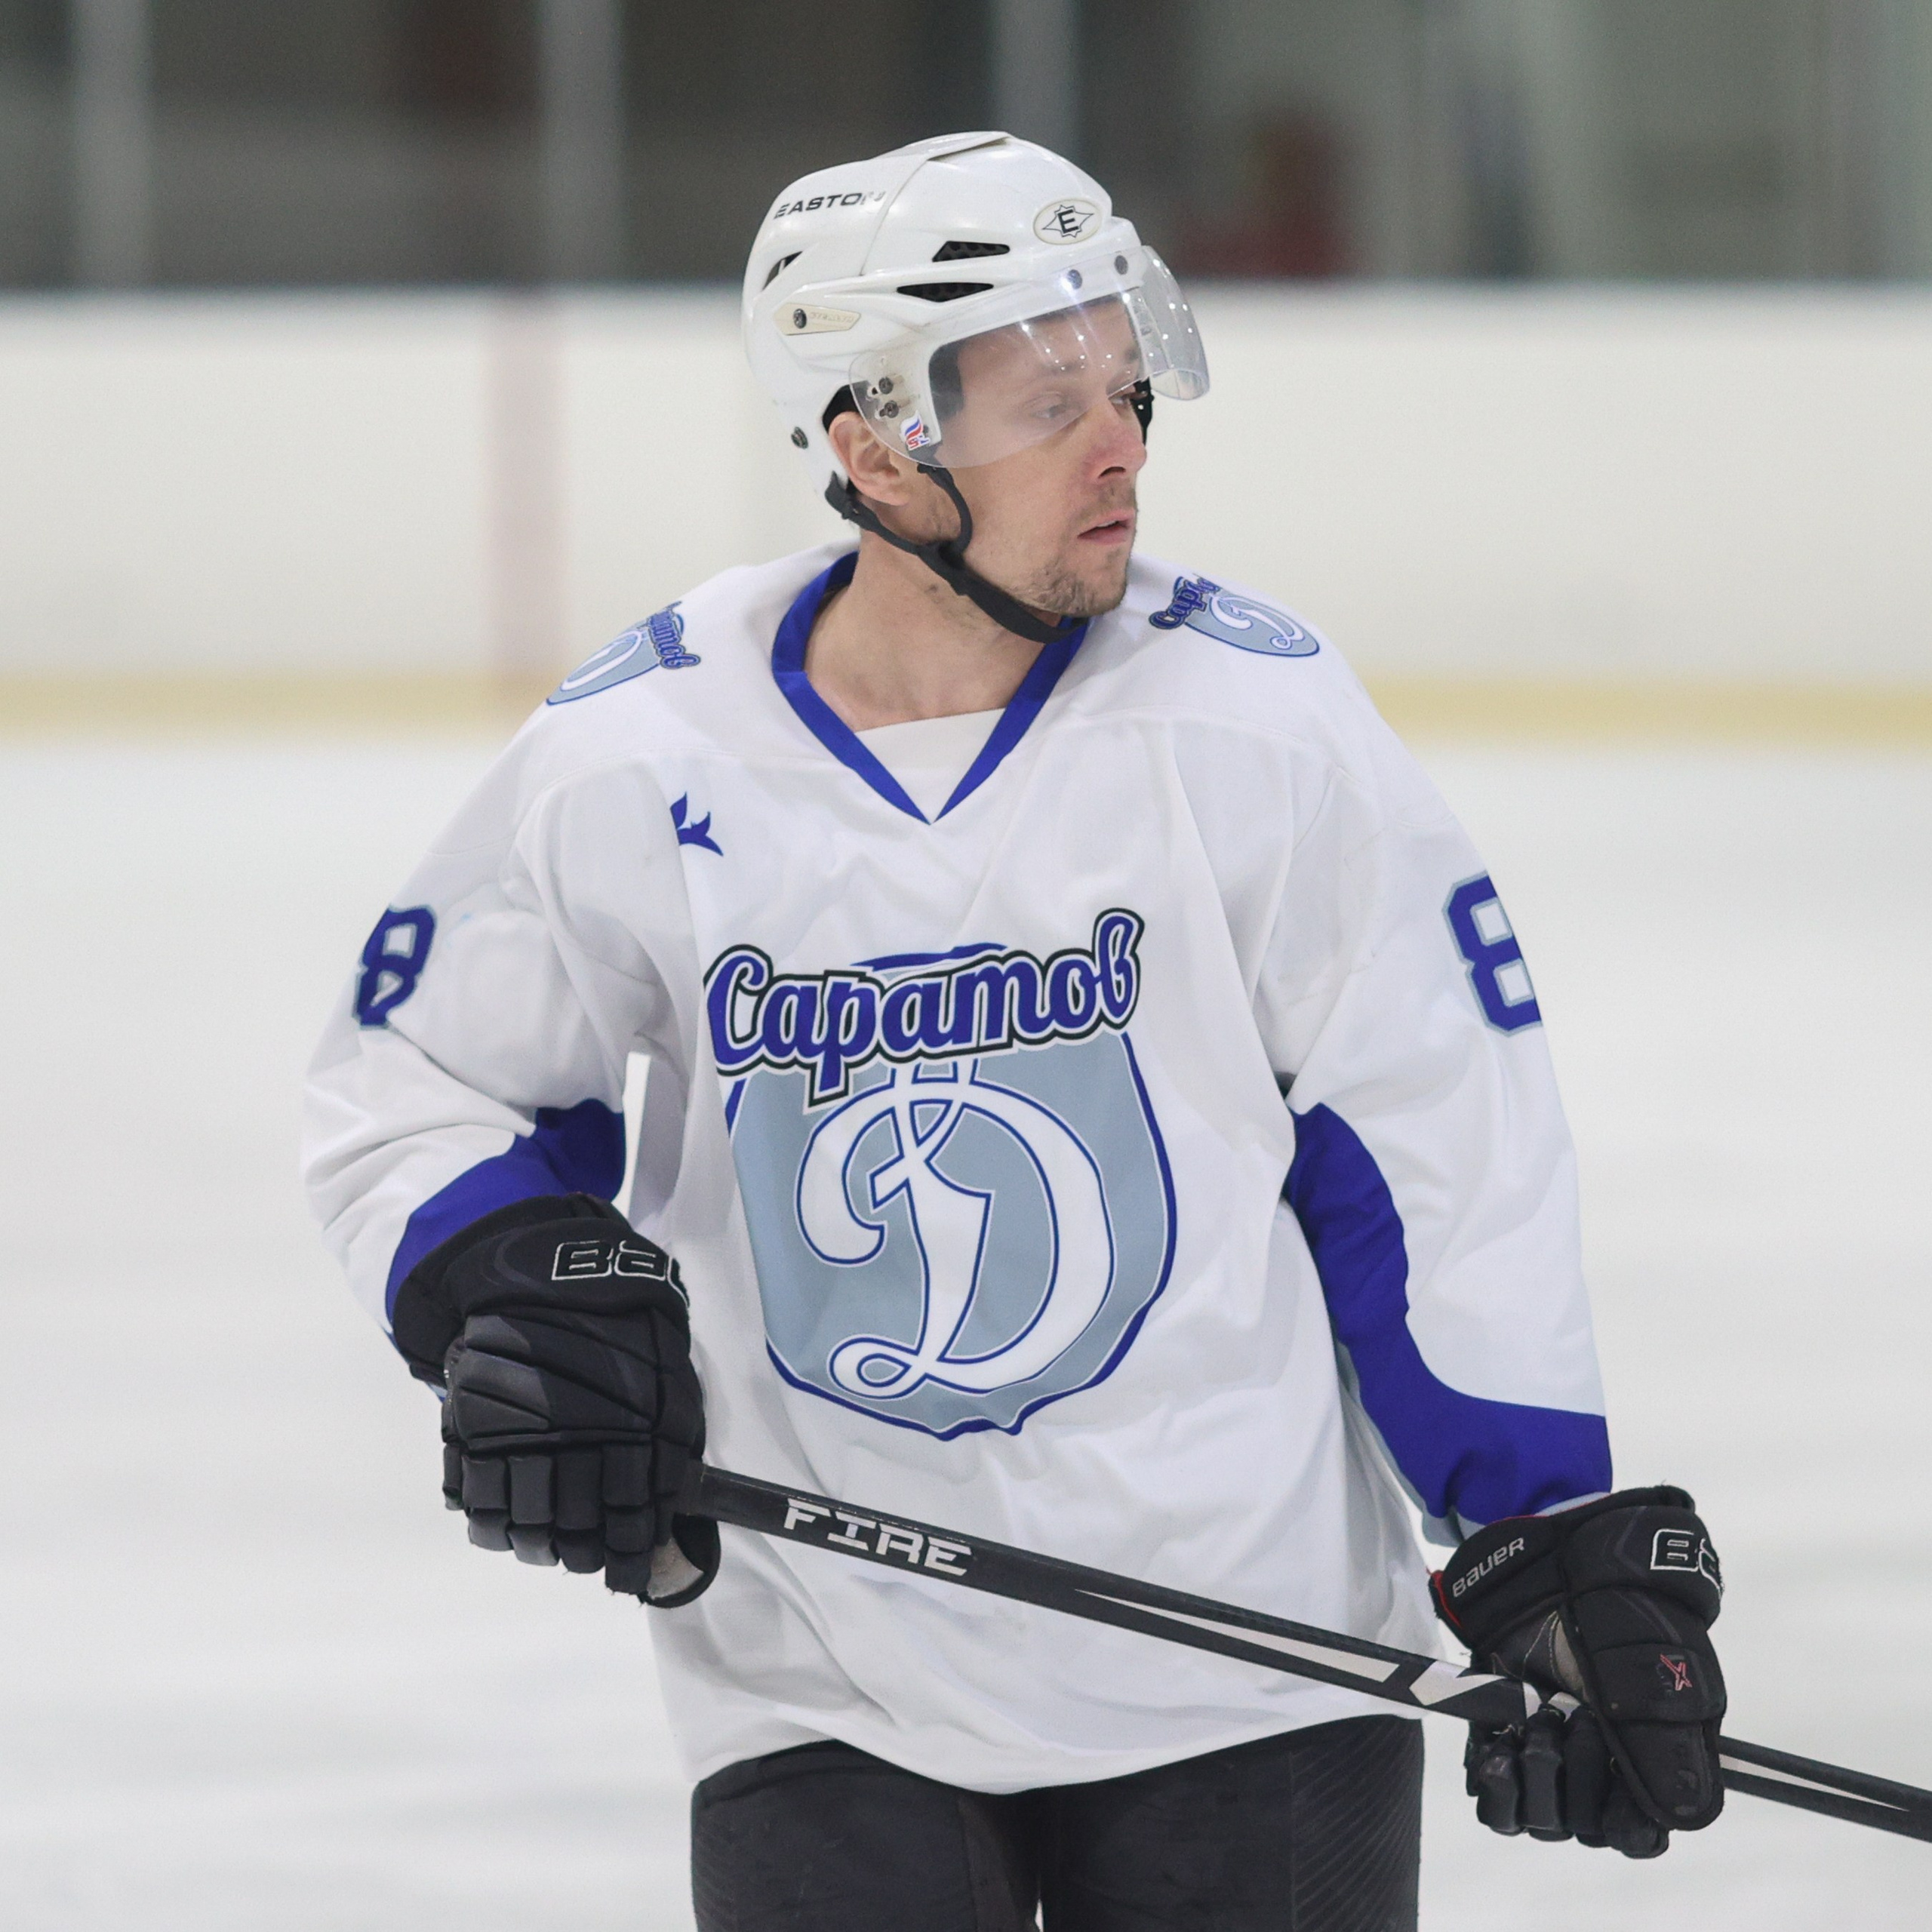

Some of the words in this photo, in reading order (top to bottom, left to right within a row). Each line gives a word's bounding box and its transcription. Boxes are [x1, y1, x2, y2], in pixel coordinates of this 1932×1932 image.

[352, 905, 436, 1031] 8
[1441, 870, 1543, 1038] 8
[783, 1497, 973, 1577] FIRE
